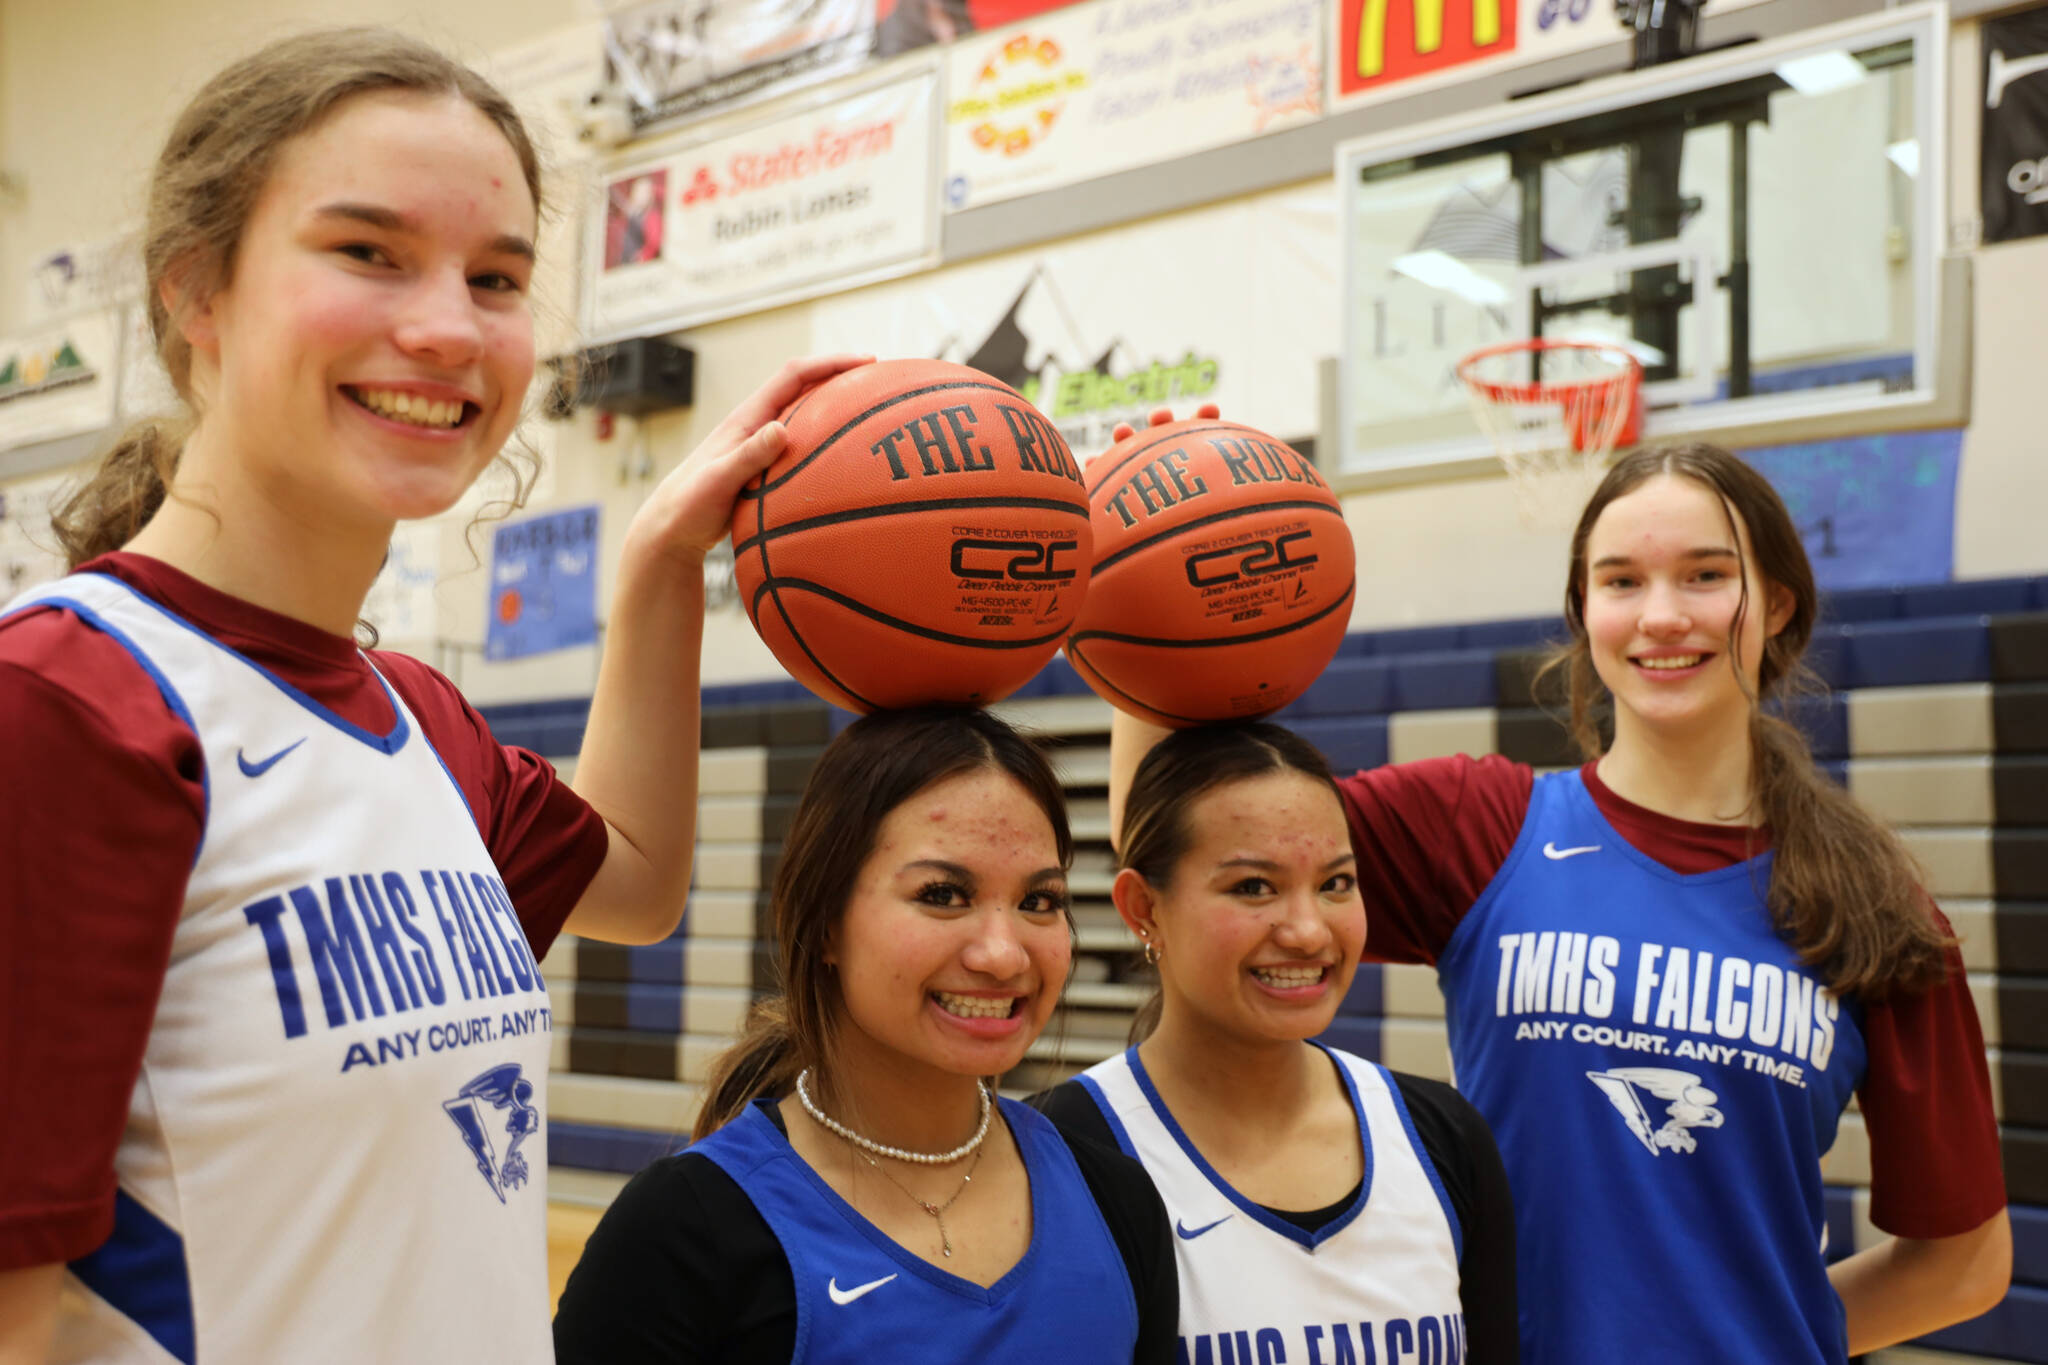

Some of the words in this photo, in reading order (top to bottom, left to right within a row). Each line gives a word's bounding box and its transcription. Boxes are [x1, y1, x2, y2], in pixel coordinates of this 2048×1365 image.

[726, 117, 896, 197] StateFarm
[1053, 352, 1219, 418] Electric
[870, 404, 996, 482] THE
[1104, 447, 1209, 529] THE
[1207, 437, 1323, 489] ROCK
[950, 538, 1078, 581] C2C
[952, 526, 984, 537] CORE
[994, 529, 1028, 539] COVER
[1182, 541, 1210, 554] CORE
[1218, 532, 1253, 547] COVER
[1185, 529, 1319, 588] C2C
[242, 871, 447, 1040] TMHS
[420, 870, 546, 1001] FALCO
[1496, 931, 1621, 1019] TMHS
[1632, 943, 1840, 1073] FALCONS
[340, 1028, 421, 1074] ANY
[428, 1015, 498, 1053] COURT.
[501, 1008, 538, 1039] ANY
[1515, 1021, 1570, 1042] ANY
[1571, 1022, 1671, 1056] COURT.
[1674, 1040, 1739, 1067] ANY
[1741, 1050, 1808, 1089] TIME.
[1303, 1312, 1466, 1365] FALCON
